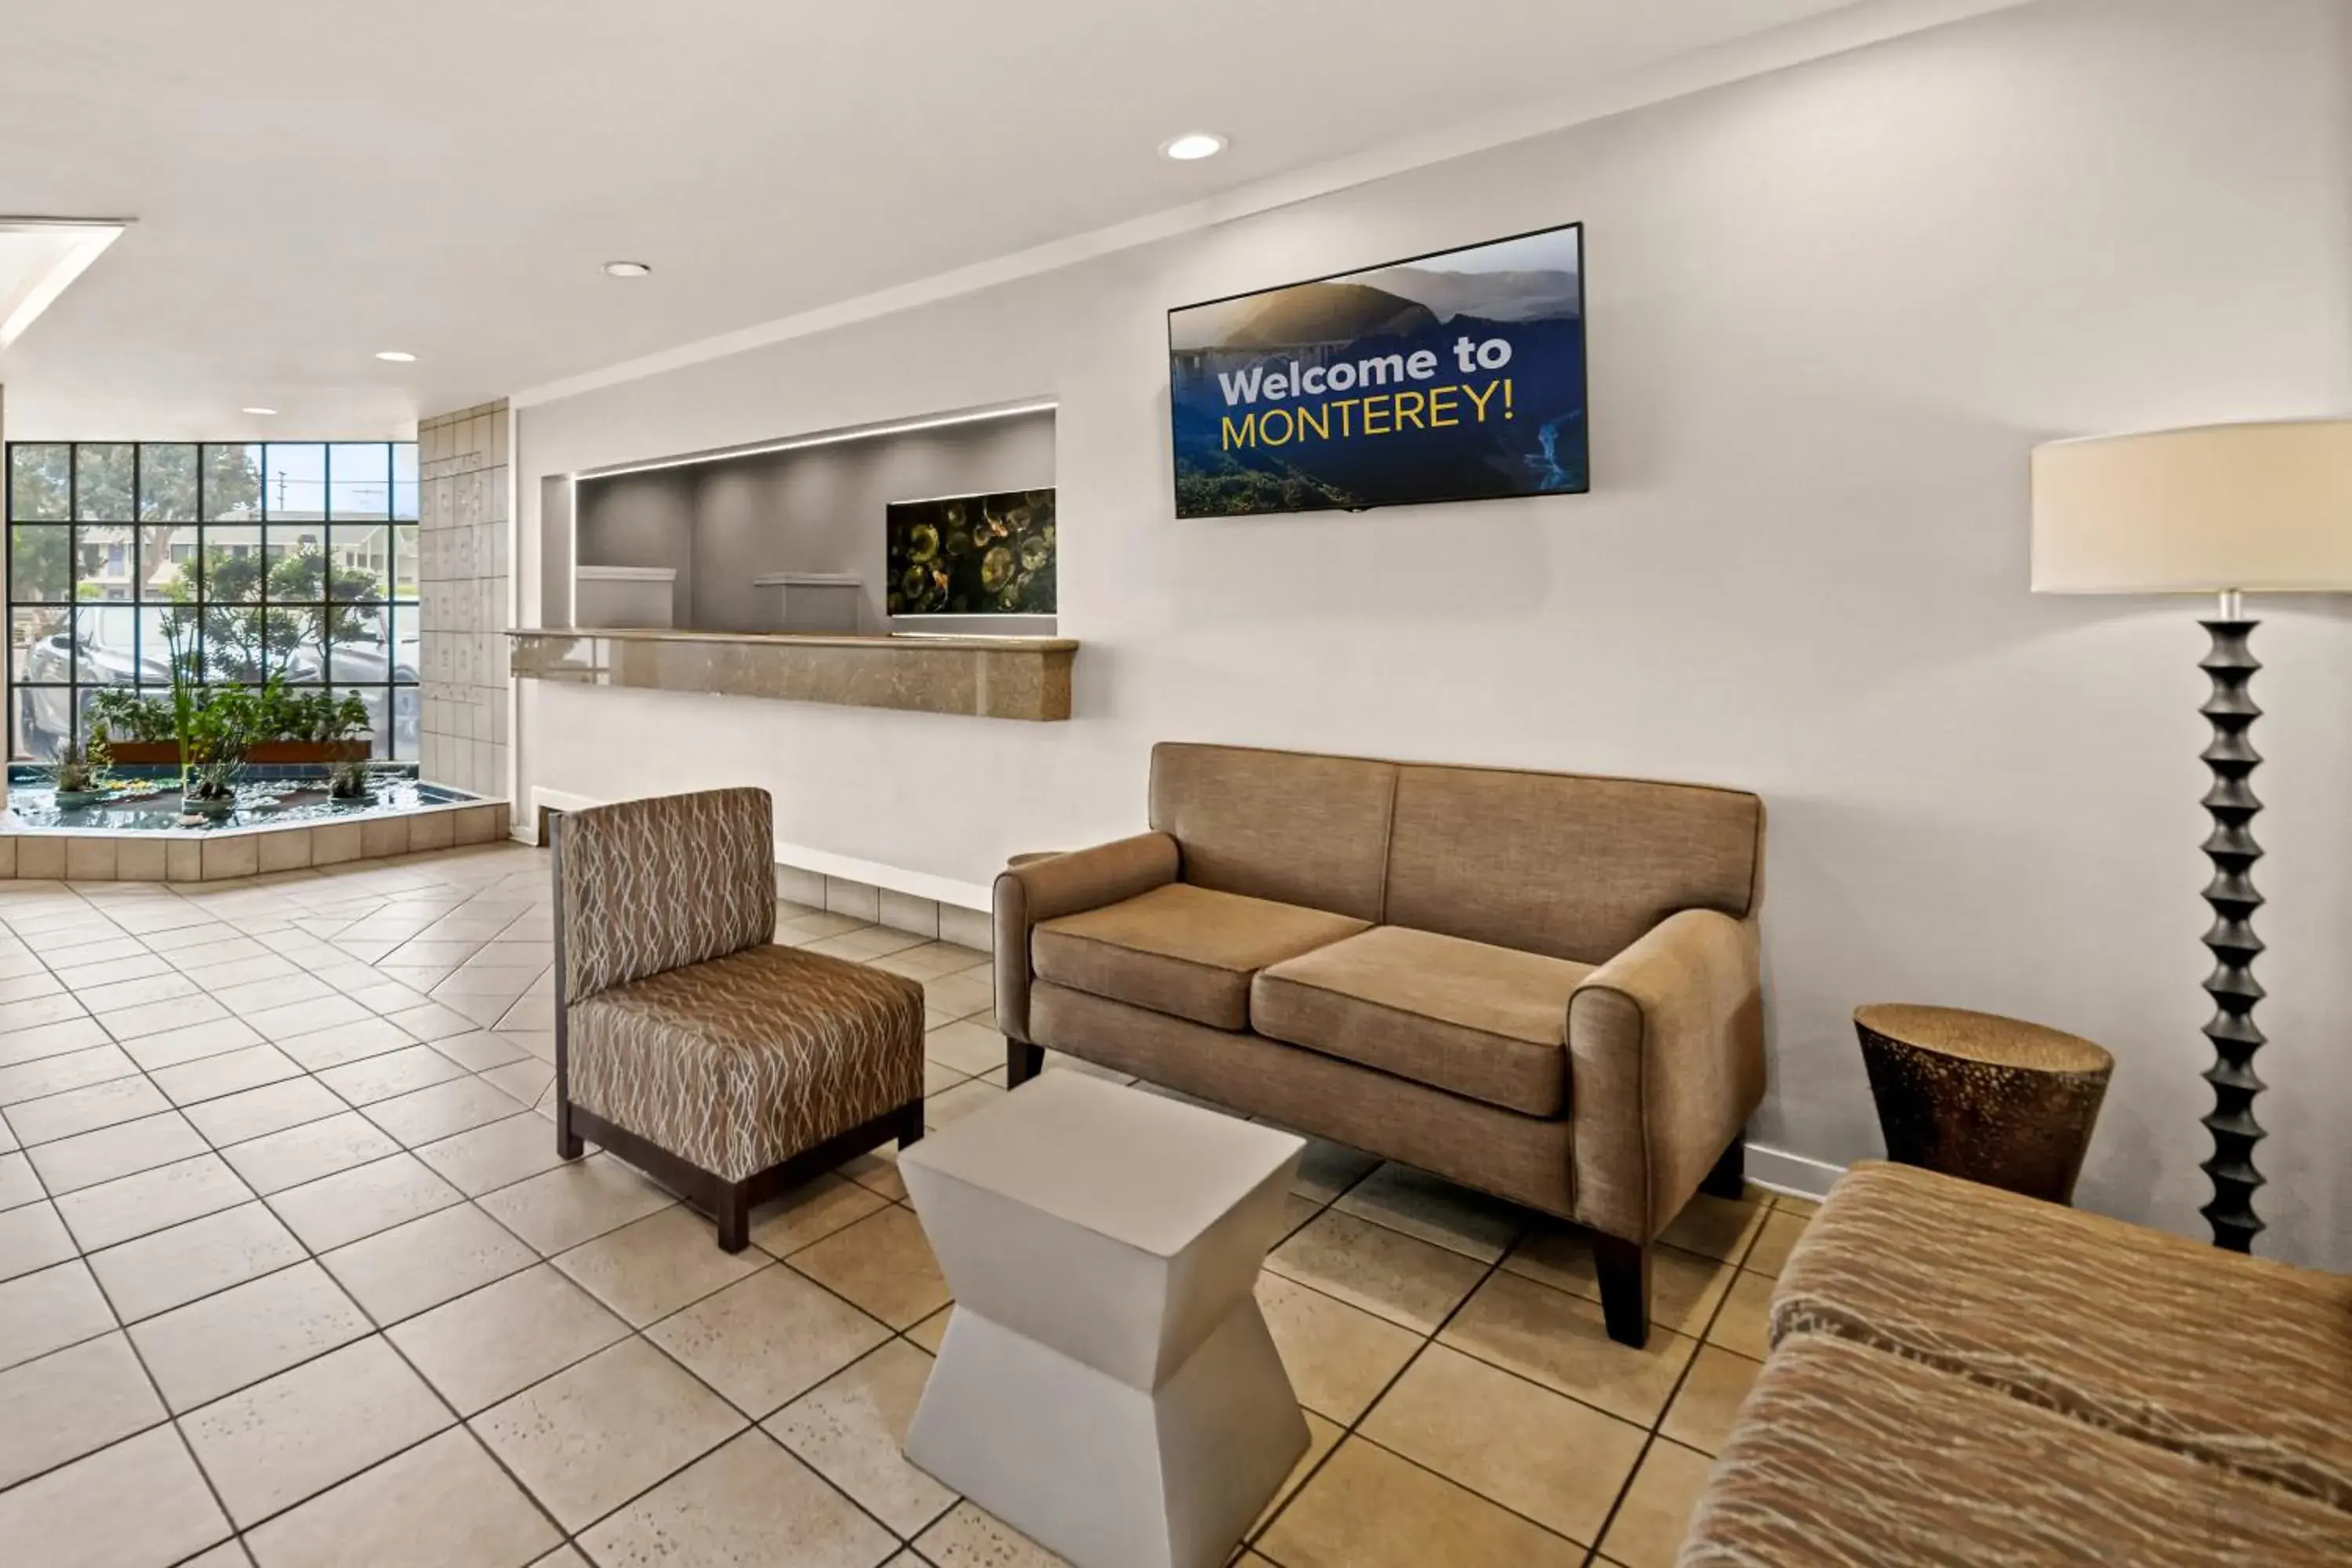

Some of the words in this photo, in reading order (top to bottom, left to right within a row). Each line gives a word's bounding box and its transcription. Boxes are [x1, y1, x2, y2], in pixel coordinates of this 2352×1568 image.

[1218, 349, 1438, 406] Welcome
[1453, 336, 1512, 372] to
[1221, 379, 1513, 451] MONTEREY!
